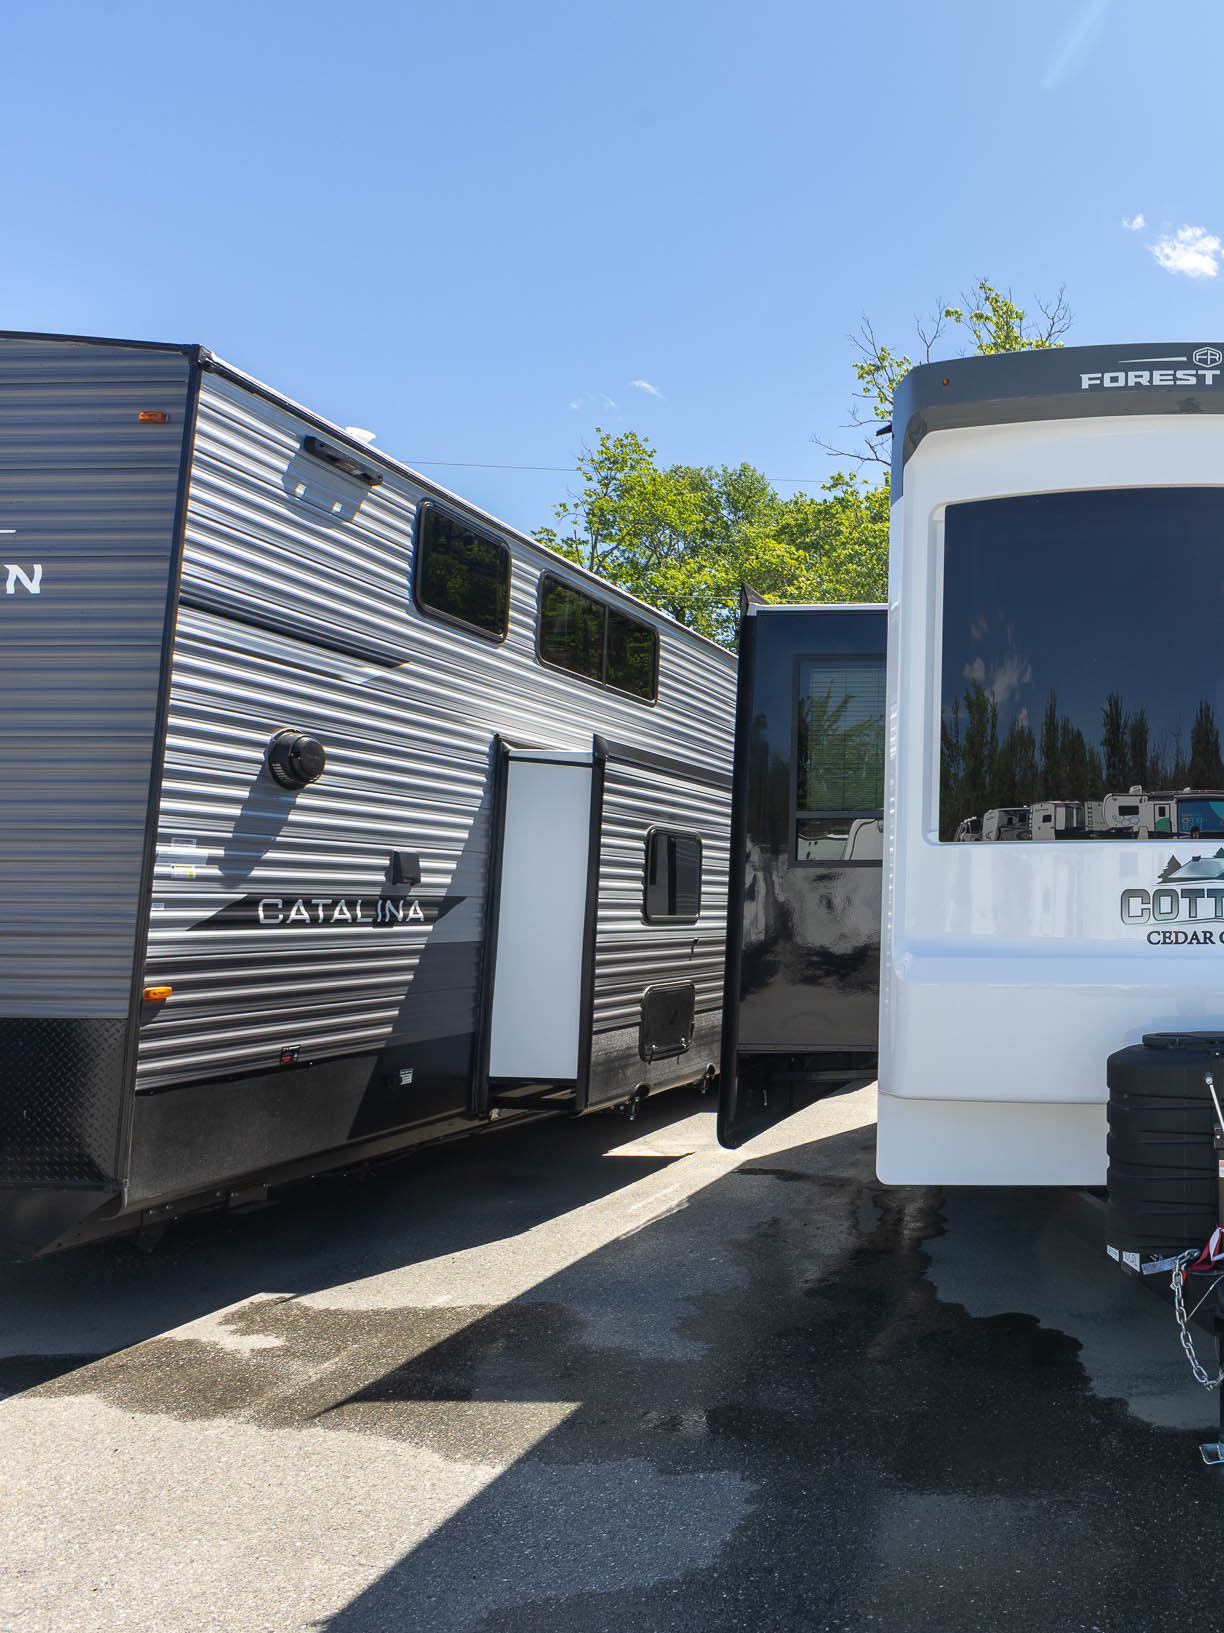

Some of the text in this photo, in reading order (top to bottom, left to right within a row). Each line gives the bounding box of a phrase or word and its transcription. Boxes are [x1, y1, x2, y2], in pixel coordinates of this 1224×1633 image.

[1195, 352, 1220, 366] FR
[1080, 369, 1221, 390] FOREST
[257, 898, 425, 925] CATALINA
[1146, 930, 1216, 946] CEDAR
